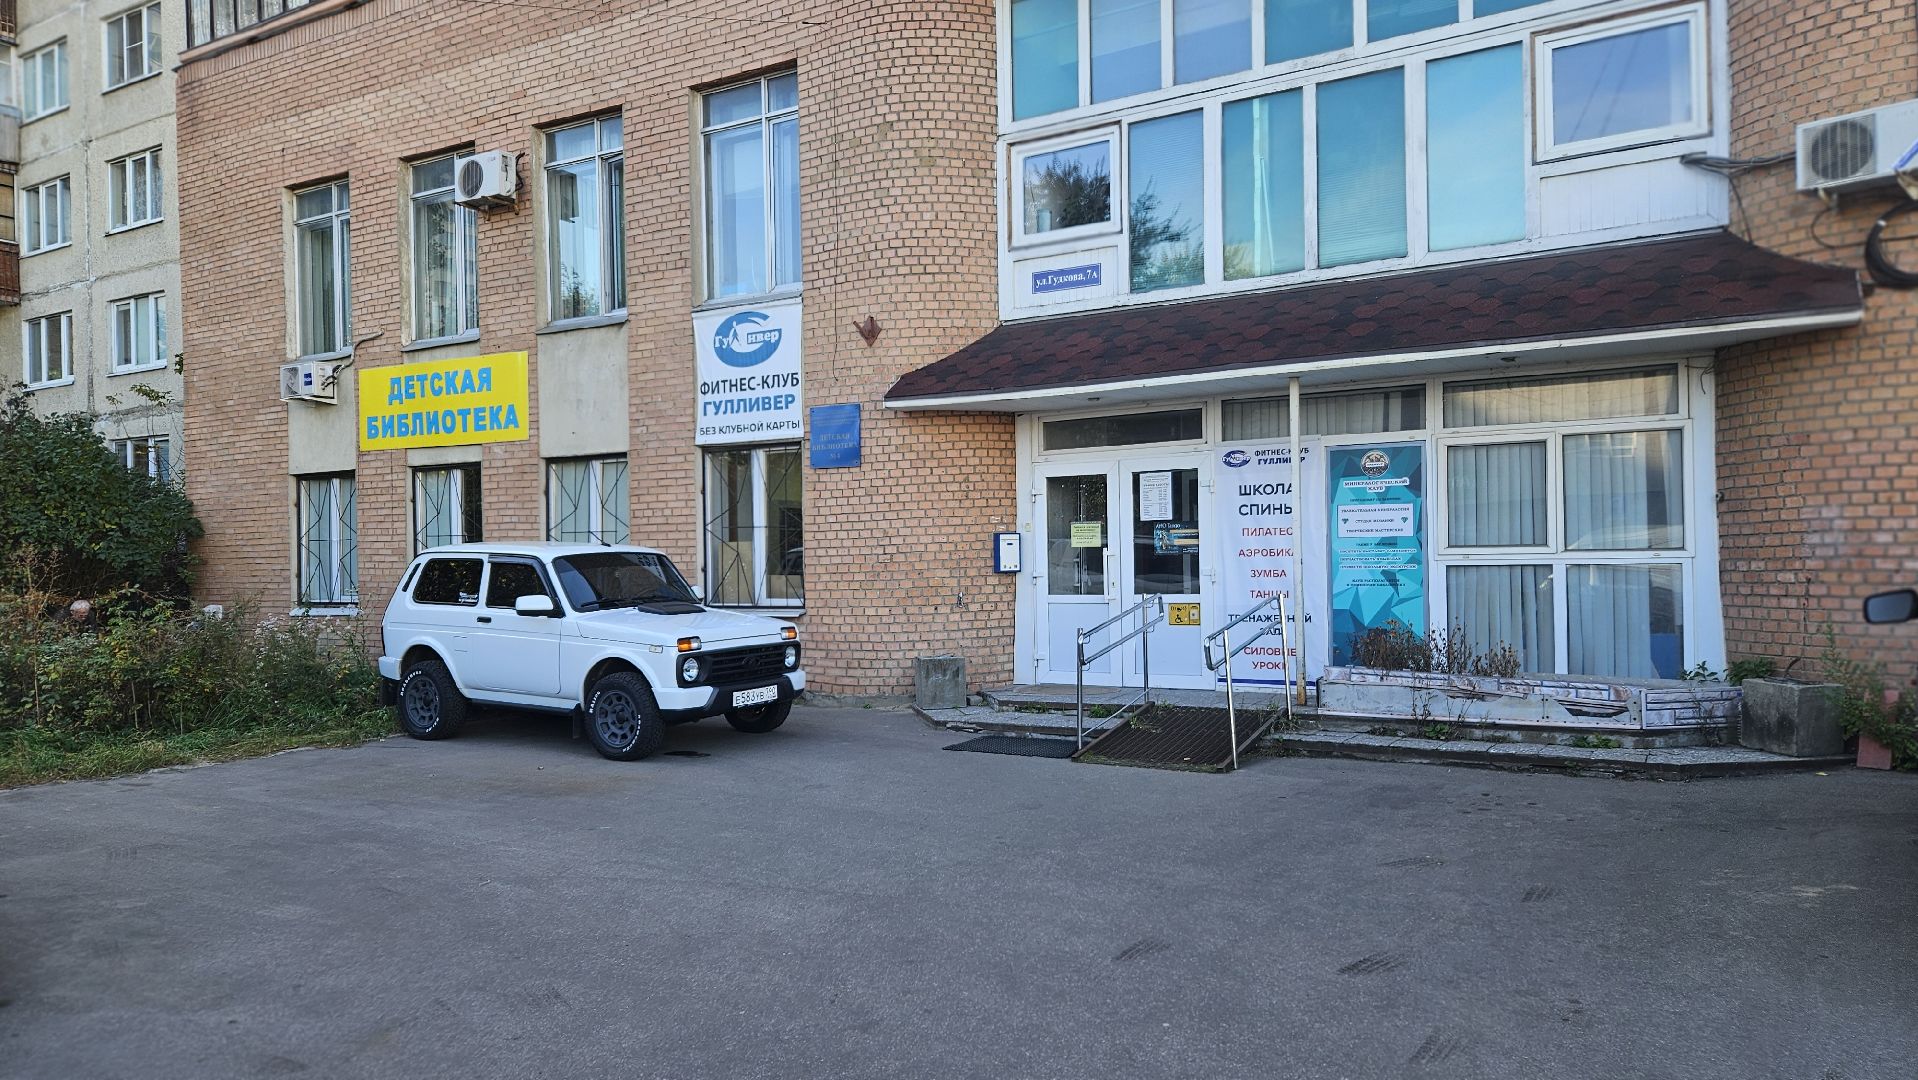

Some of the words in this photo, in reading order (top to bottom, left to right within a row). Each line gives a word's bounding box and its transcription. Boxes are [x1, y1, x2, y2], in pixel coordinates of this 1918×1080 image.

[387, 366, 492, 406] ДЕТСКАЯ
[700, 372, 800, 396] ФИТНЕС-КЛУБ
[703, 393, 796, 416] ГУЛЛИВЕР
[366, 403, 520, 440] БИБЛИОТЕКА
[699, 426, 717, 436] БЕЗ
[718, 420, 764, 435] КЛУБНОЙ
[766, 419, 800, 431] КАРТЫ
[1242, 527, 1293, 537] ПИЛАТЕС
[1250, 569, 1287, 578] ЗУМБА
